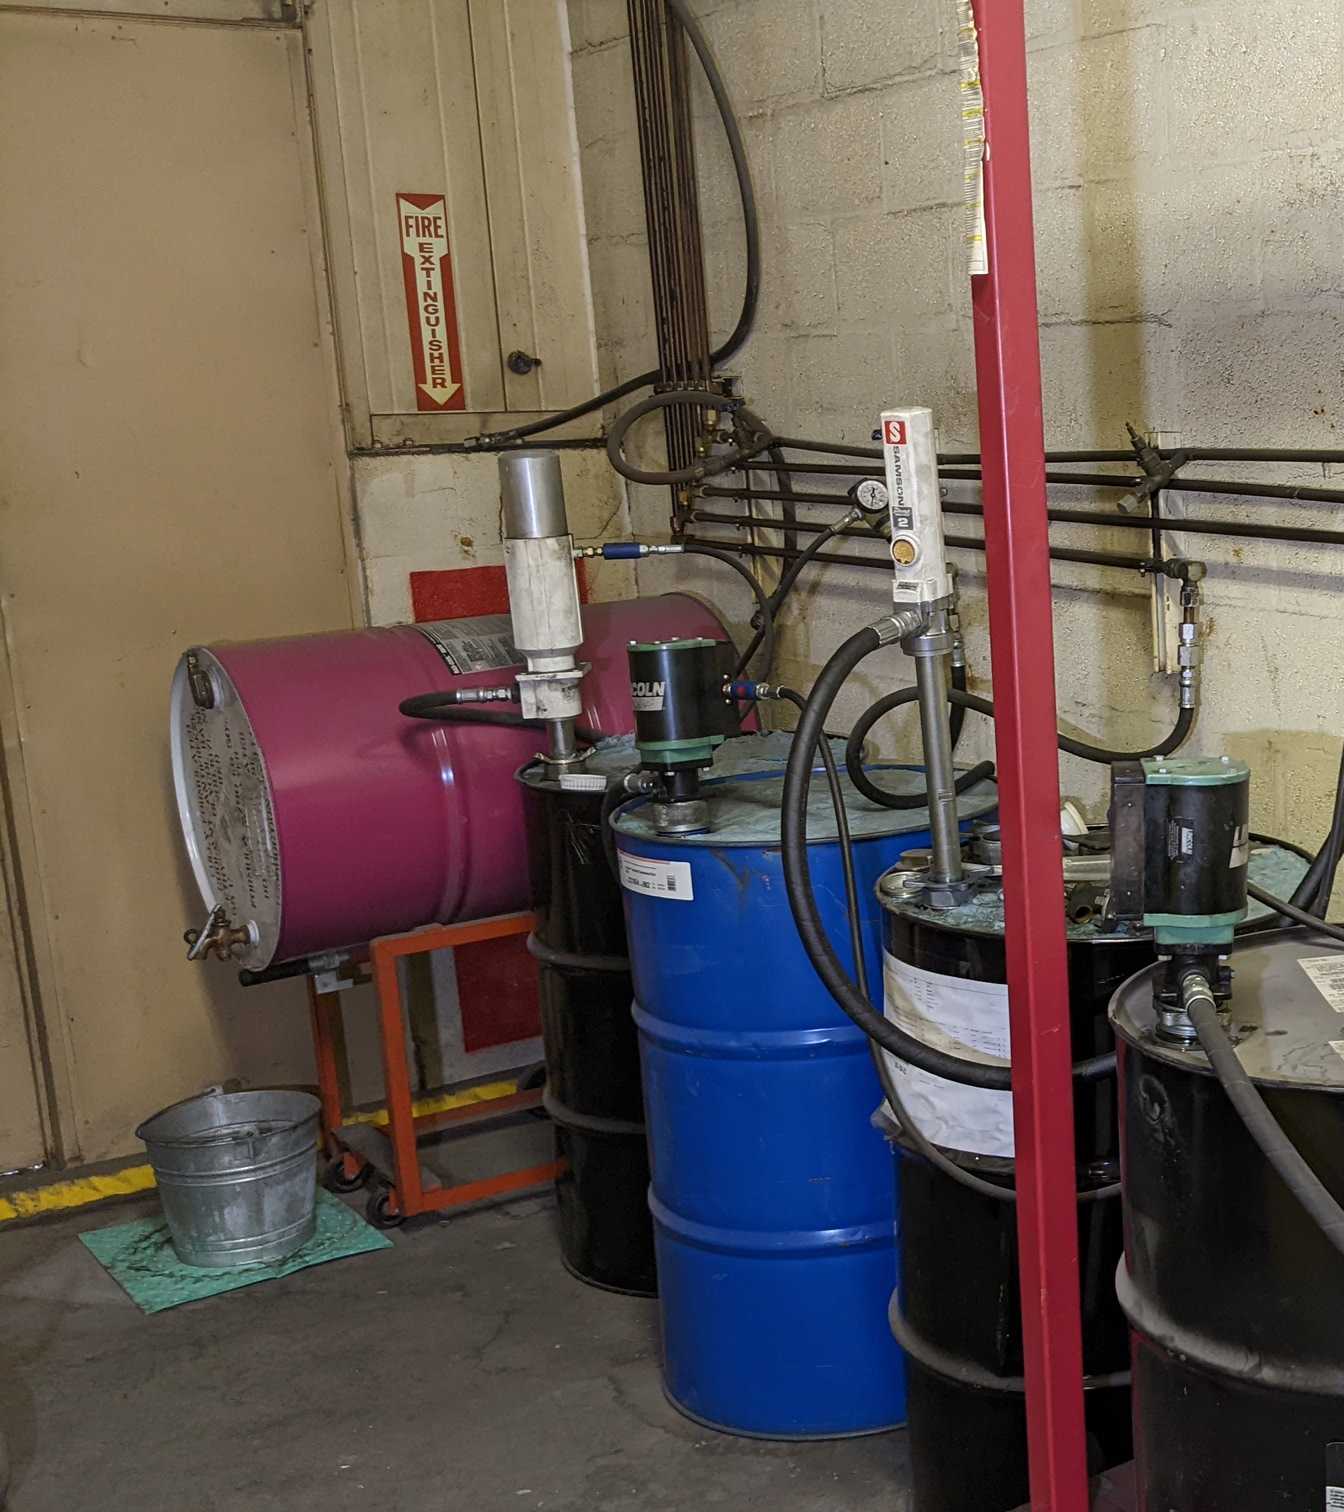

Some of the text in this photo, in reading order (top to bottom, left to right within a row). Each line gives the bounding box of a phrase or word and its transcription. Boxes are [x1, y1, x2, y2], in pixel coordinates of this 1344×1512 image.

[404, 215, 444, 239] FIRE
[418, 242, 448, 389] EXTINGUISHER
[893, 445, 906, 507] SAMSON
